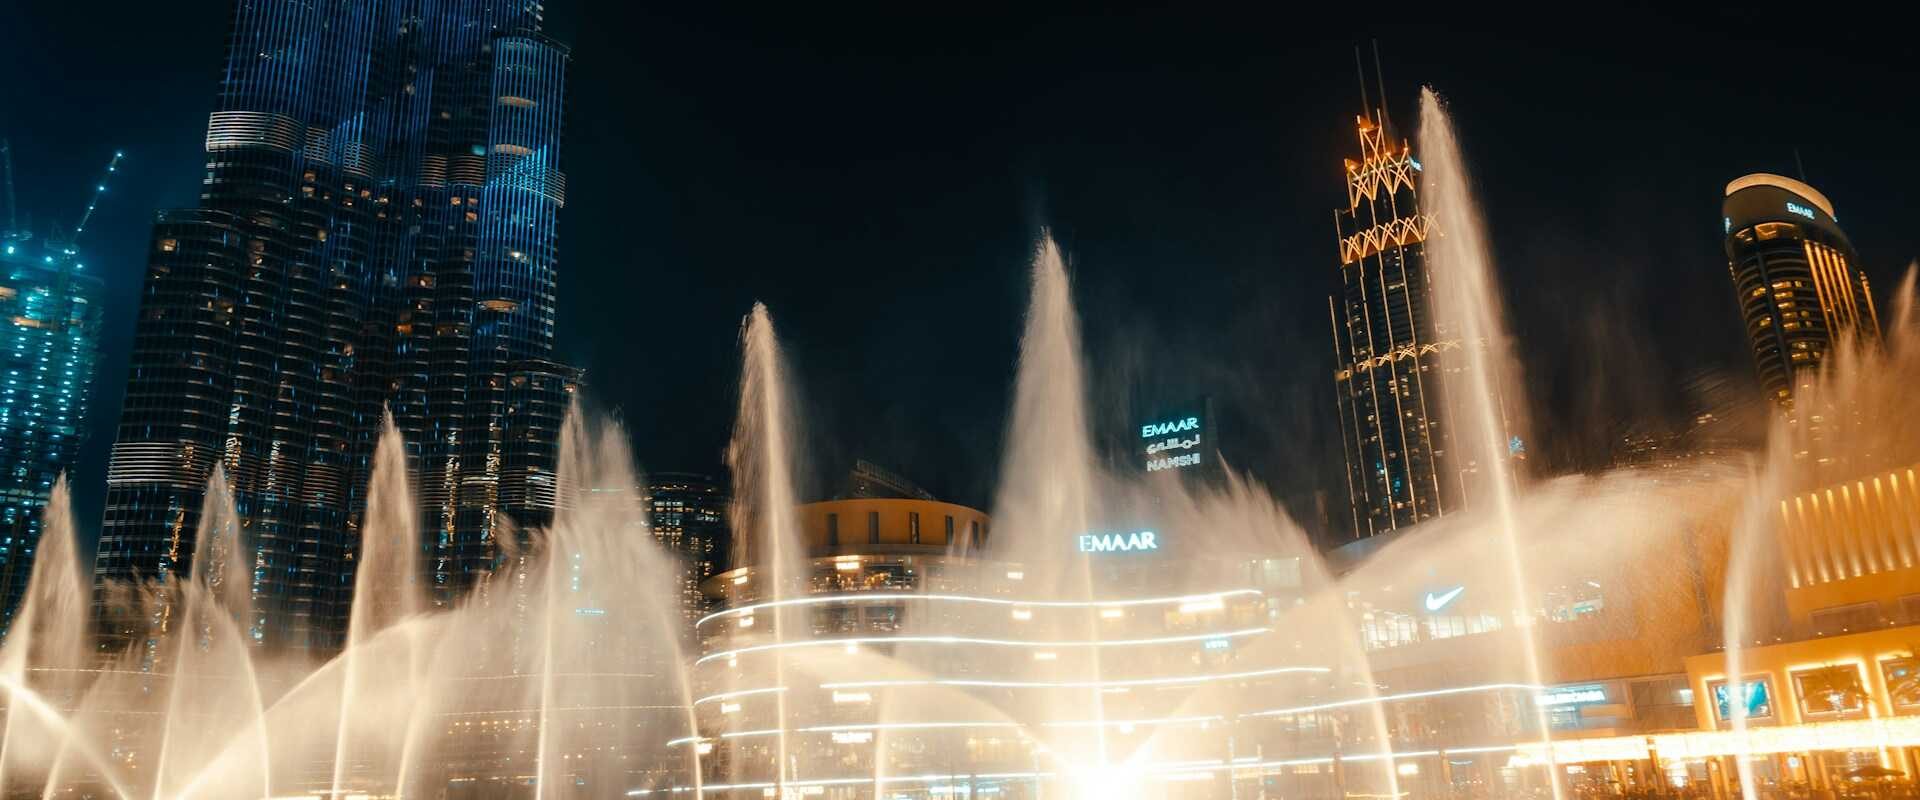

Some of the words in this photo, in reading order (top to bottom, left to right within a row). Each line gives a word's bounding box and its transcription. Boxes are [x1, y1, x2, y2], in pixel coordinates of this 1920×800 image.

[1787, 203, 1814, 219] EMAAR
[1142, 417, 1199, 437] EMAAR
[1146, 453, 1200, 472] NAMSHI
[1079, 531, 1158, 552] EMAAR
